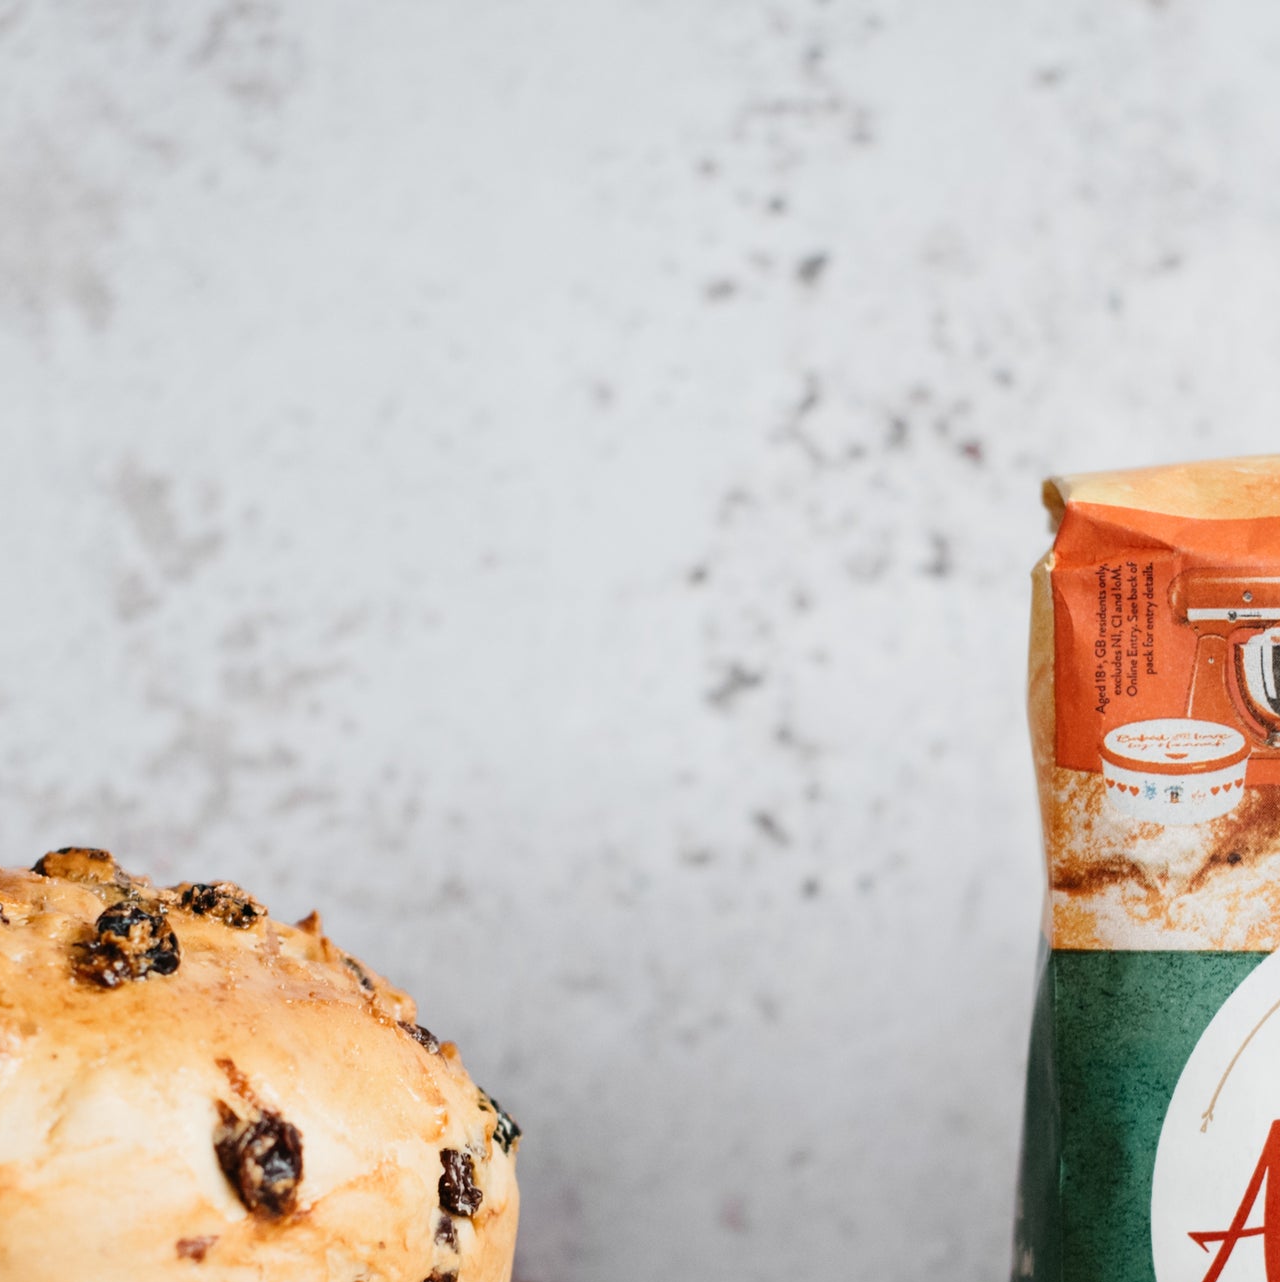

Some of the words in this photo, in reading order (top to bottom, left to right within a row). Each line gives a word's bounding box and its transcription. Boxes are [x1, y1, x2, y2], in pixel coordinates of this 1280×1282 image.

[1096, 563, 1109, 588] only,
[1126, 562, 1137, 573] of
[1127, 576, 1137, 600] back
[1143, 562, 1154, 599] details.
[1095, 590, 1107, 637] residents
[1111, 594, 1122, 613] and
[1128, 602, 1138, 622] See
[1144, 602, 1157, 629] entry
[1095, 640, 1106, 658] GB
[1127, 625, 1141, 656] Entry.
[1143, 632, 1153, 647] for
[1096, 660, 1108, 682] 18+,
[1111, 651, 1122, 695] excludes
[1143, 651, 1157, 674] pack
[1127, 660, 1138, 697] Online
[1096, 686, 1110, 714] Aged
